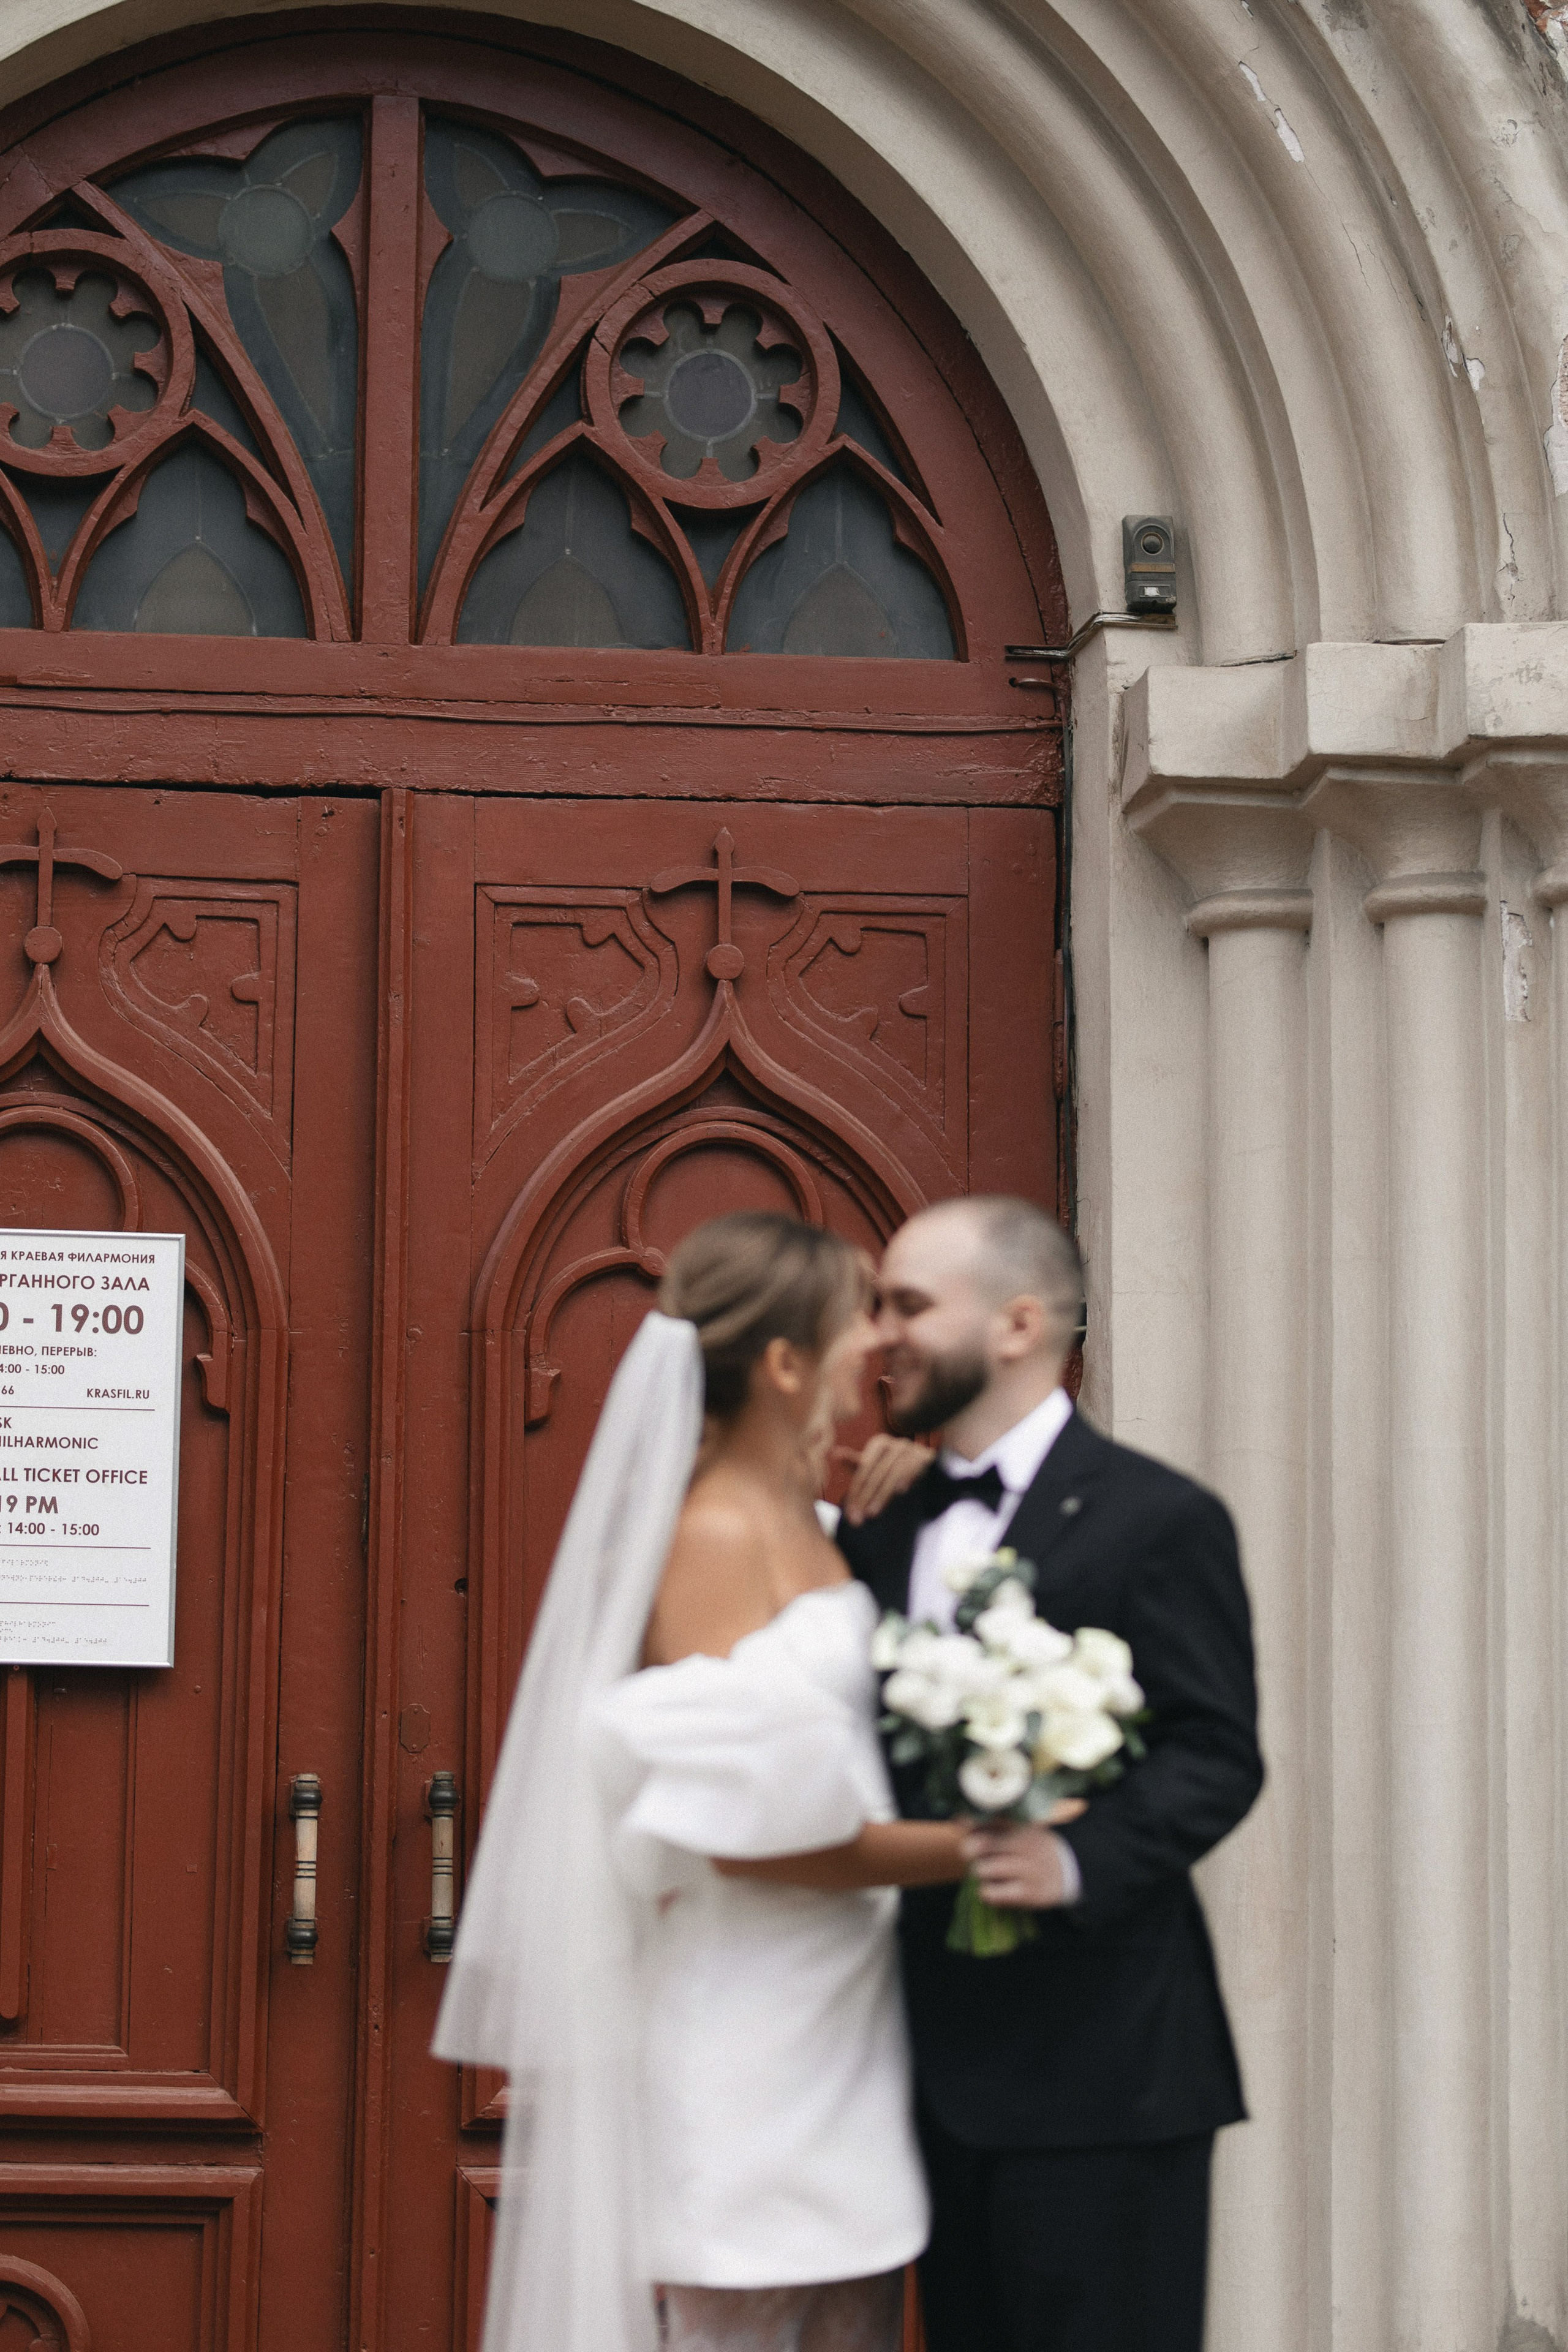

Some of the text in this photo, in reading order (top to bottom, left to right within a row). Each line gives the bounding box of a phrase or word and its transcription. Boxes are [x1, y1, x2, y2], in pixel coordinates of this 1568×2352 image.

[11, 1251, 64, 1262] КРАЕВАЯ
[67, 1252, 155, 1264] ФИЛАРМОНИЯ
[0, 1273, 150, 1291] РГАННОГО ЗАЛА
[51, 1303, 144, 1335] 19:00
[0, 1345, 97, 1357] ЕВНО, ПЕРЕРЫВ:
[35, 1365, 65, 1374] 15:00
[1, 1385, 15, 1395] 66
[86, 1388, 149, 1400] KRASFIL.RU
[0, 1435, 99, 1450] ILHARMONIC
[0, 1467, 148, 1485] LL TICKET OFFICE
[0, 1494, 58, 1514] 9 PM
[8, 1522, 45, 1535] 14:00
[62, 1523, 100, 1536] 15:00
